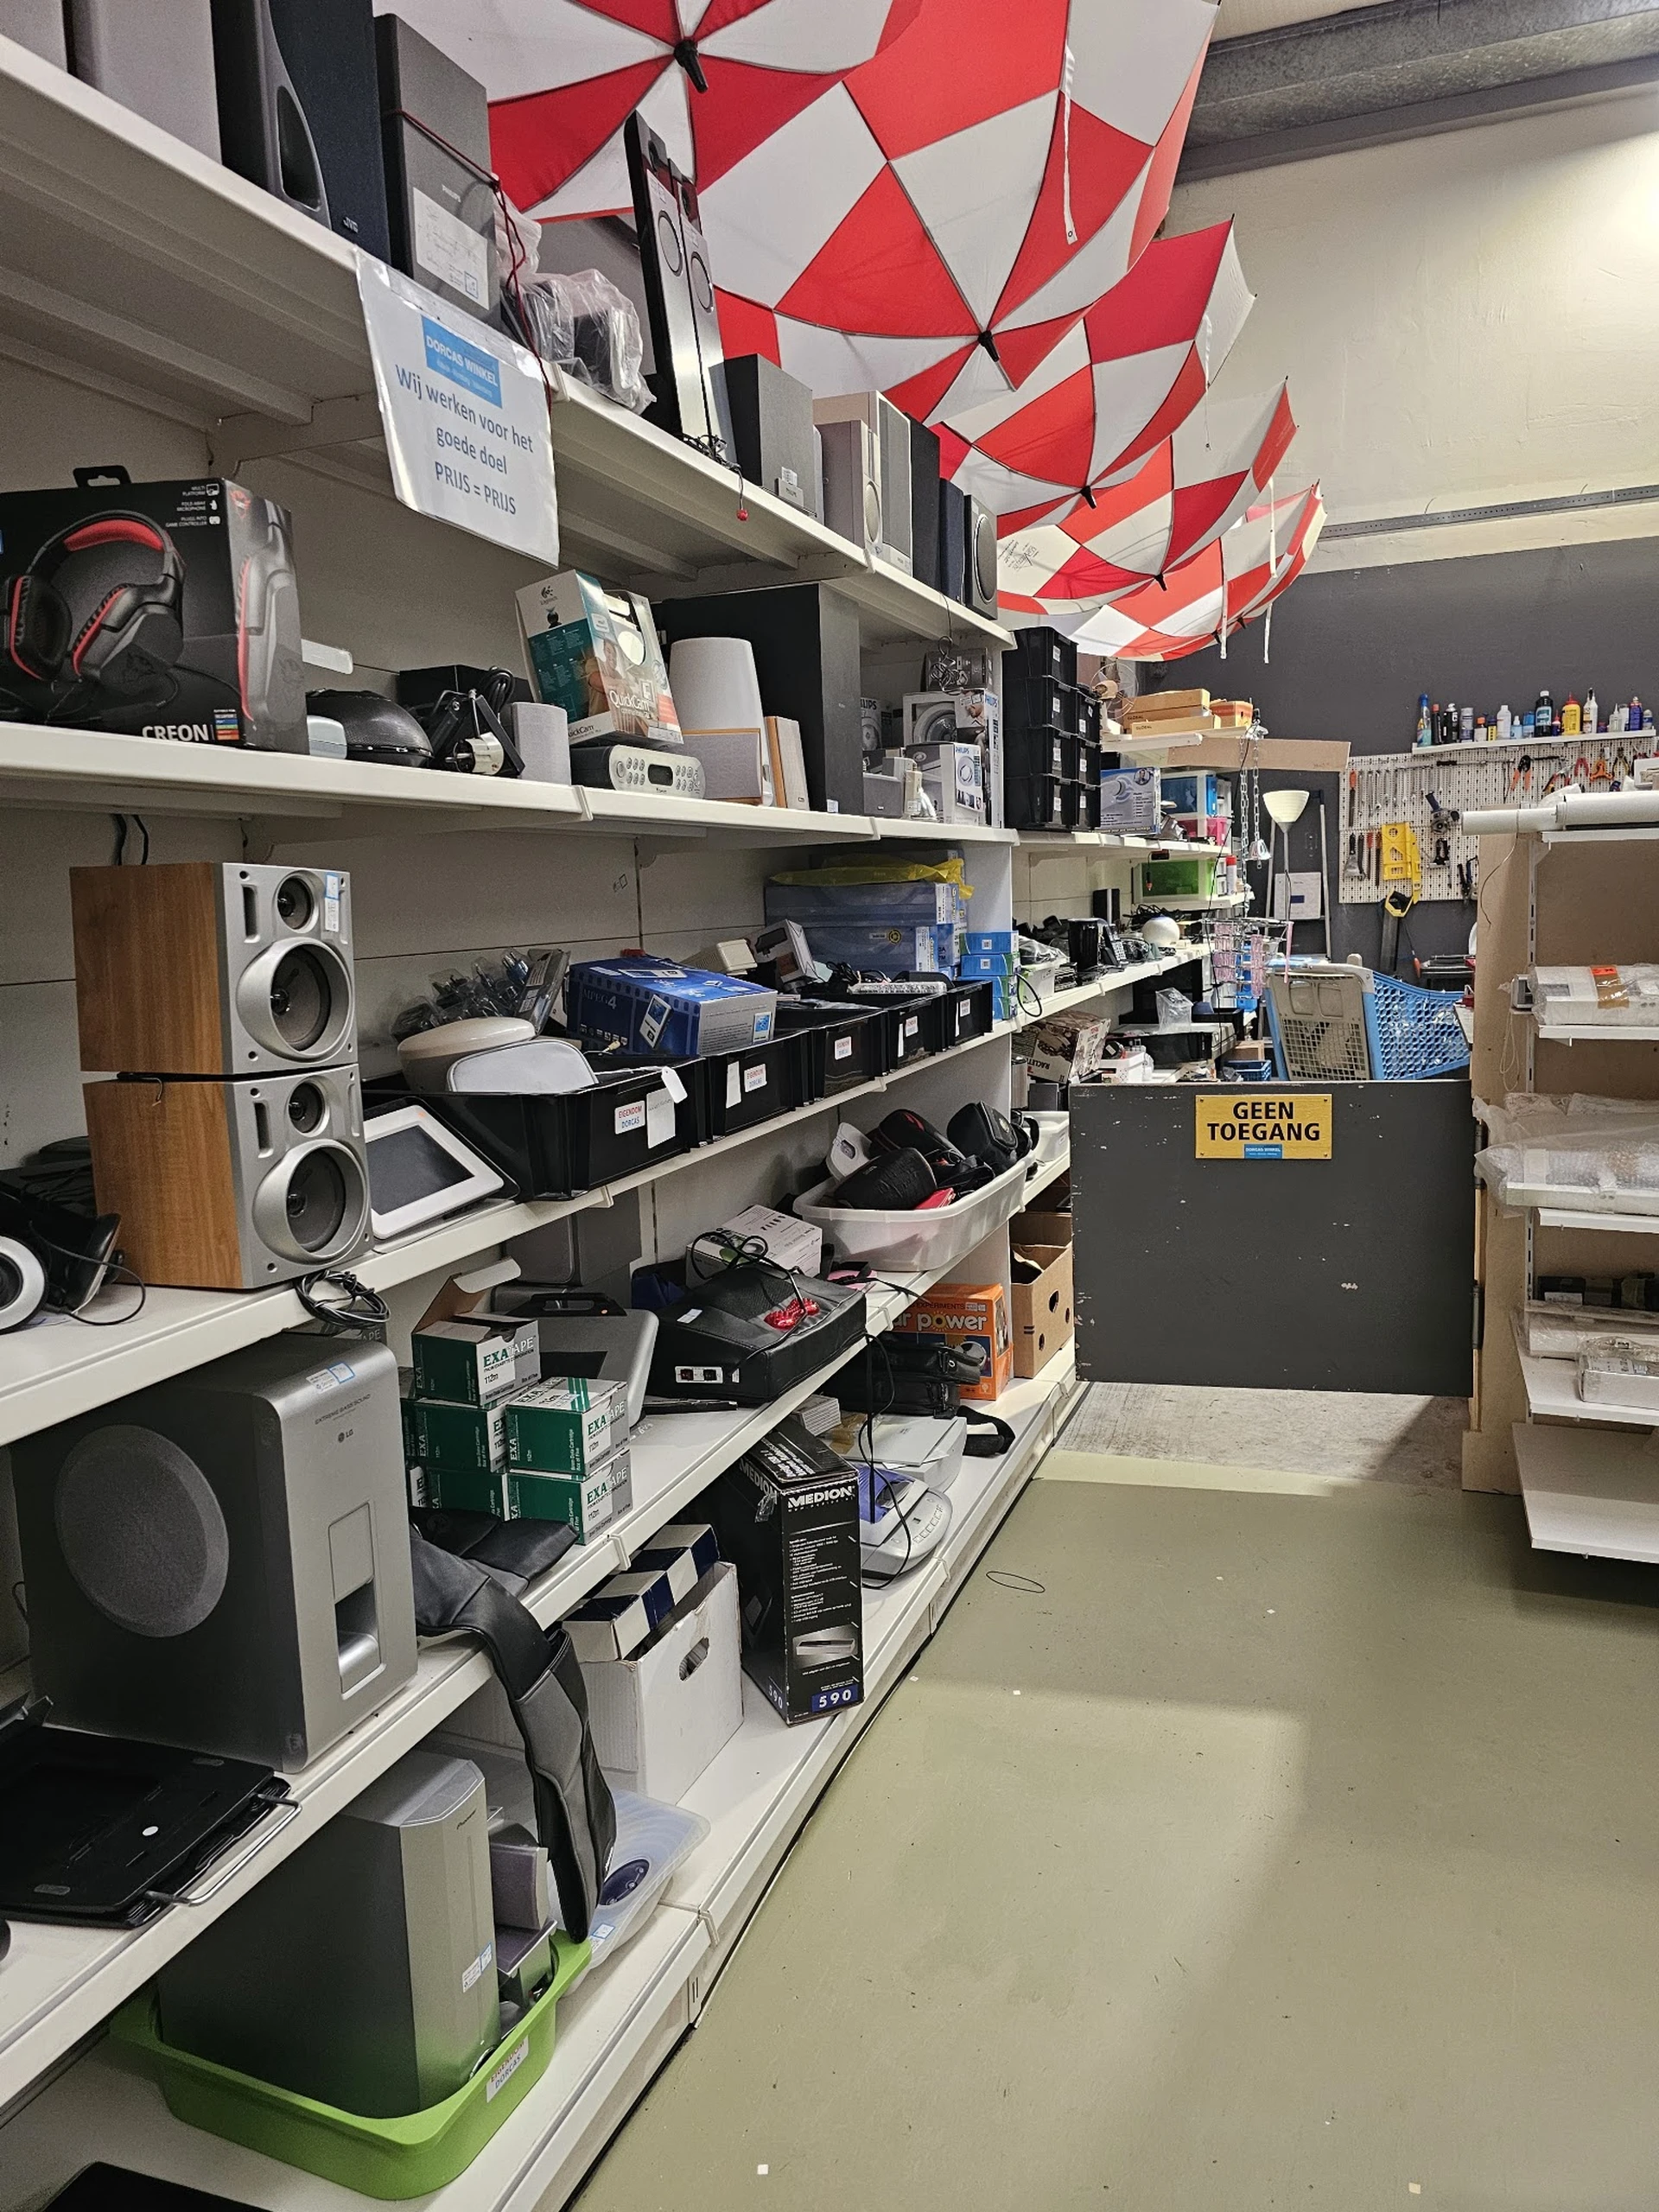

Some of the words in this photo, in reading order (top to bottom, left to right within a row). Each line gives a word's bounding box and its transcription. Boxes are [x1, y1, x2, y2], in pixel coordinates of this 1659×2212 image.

[343, 217, 359, 233] JVC
[426, 335, 464, 367] DORCAS
[464, 356, 499, 387] WINKEL
[395, 364, 423, 400] Wij
[425, 385, 476, 425] werken
[479, 413, 508, 441] voor
[512, 425, 534, 454] het
[436, 427, 476, 461] goede
[480, 444, 507, 475] doel
[435, 461, 470, 495] PRIJS
[484, 484, 516, 516] PRIJS
[609, 690, 650, 712] QuickCam
[142, 723, 209, 741] CREON
[618, 1105, 643, 1119] EIGENDOM
[1232, 1101, 1294, 1121] GEEN
[621, 1116, 640, 1129] DORCAS
[1207, 1122, 1320, 1141] TOEGANG
[917, 1312, 987, 1332] power
[346, 1428, 354, 1439] LG
[739, 1457, 778, 1505] MEDION
[787, 1485, 854, 1509] MEDION
[510, 1504, 518, 1520] XA
[768, 1685, 783, 1709] 590
[818, 1688, 852, 1709] 590
[495, 2053, 521, 2089] DORCAS
